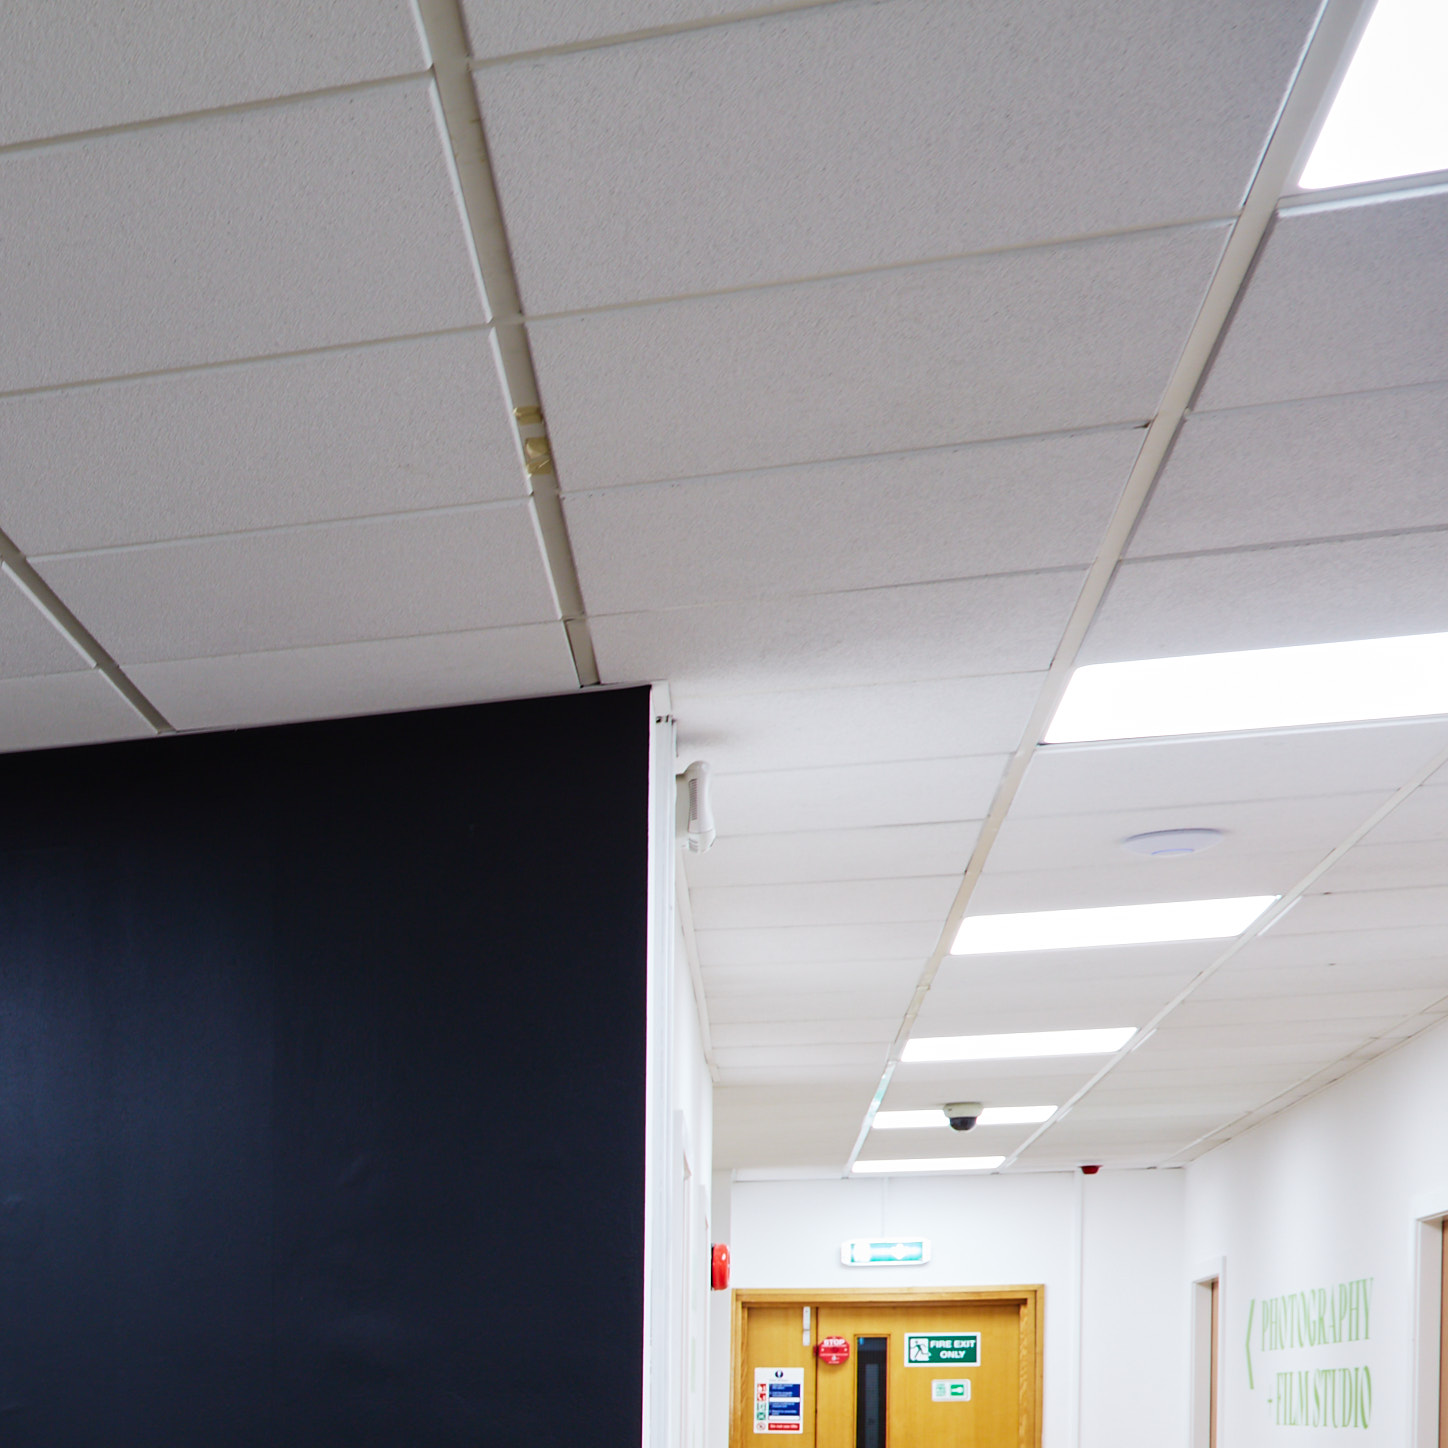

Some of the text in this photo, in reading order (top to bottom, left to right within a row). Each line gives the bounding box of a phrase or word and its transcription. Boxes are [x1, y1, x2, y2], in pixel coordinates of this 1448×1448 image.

[1261, 1277, 1374, 1352] PHOTOGRAPHY
[823, 1338, 846, 1346] STOP
[929, 1340, 976, 1349] FIRE EXIT
[939, 1350, 966, 1359] ONLY
[1275, 1371, 1309, 1426] FILM
[1312, 1365, 1372, 1429] STUDIO
